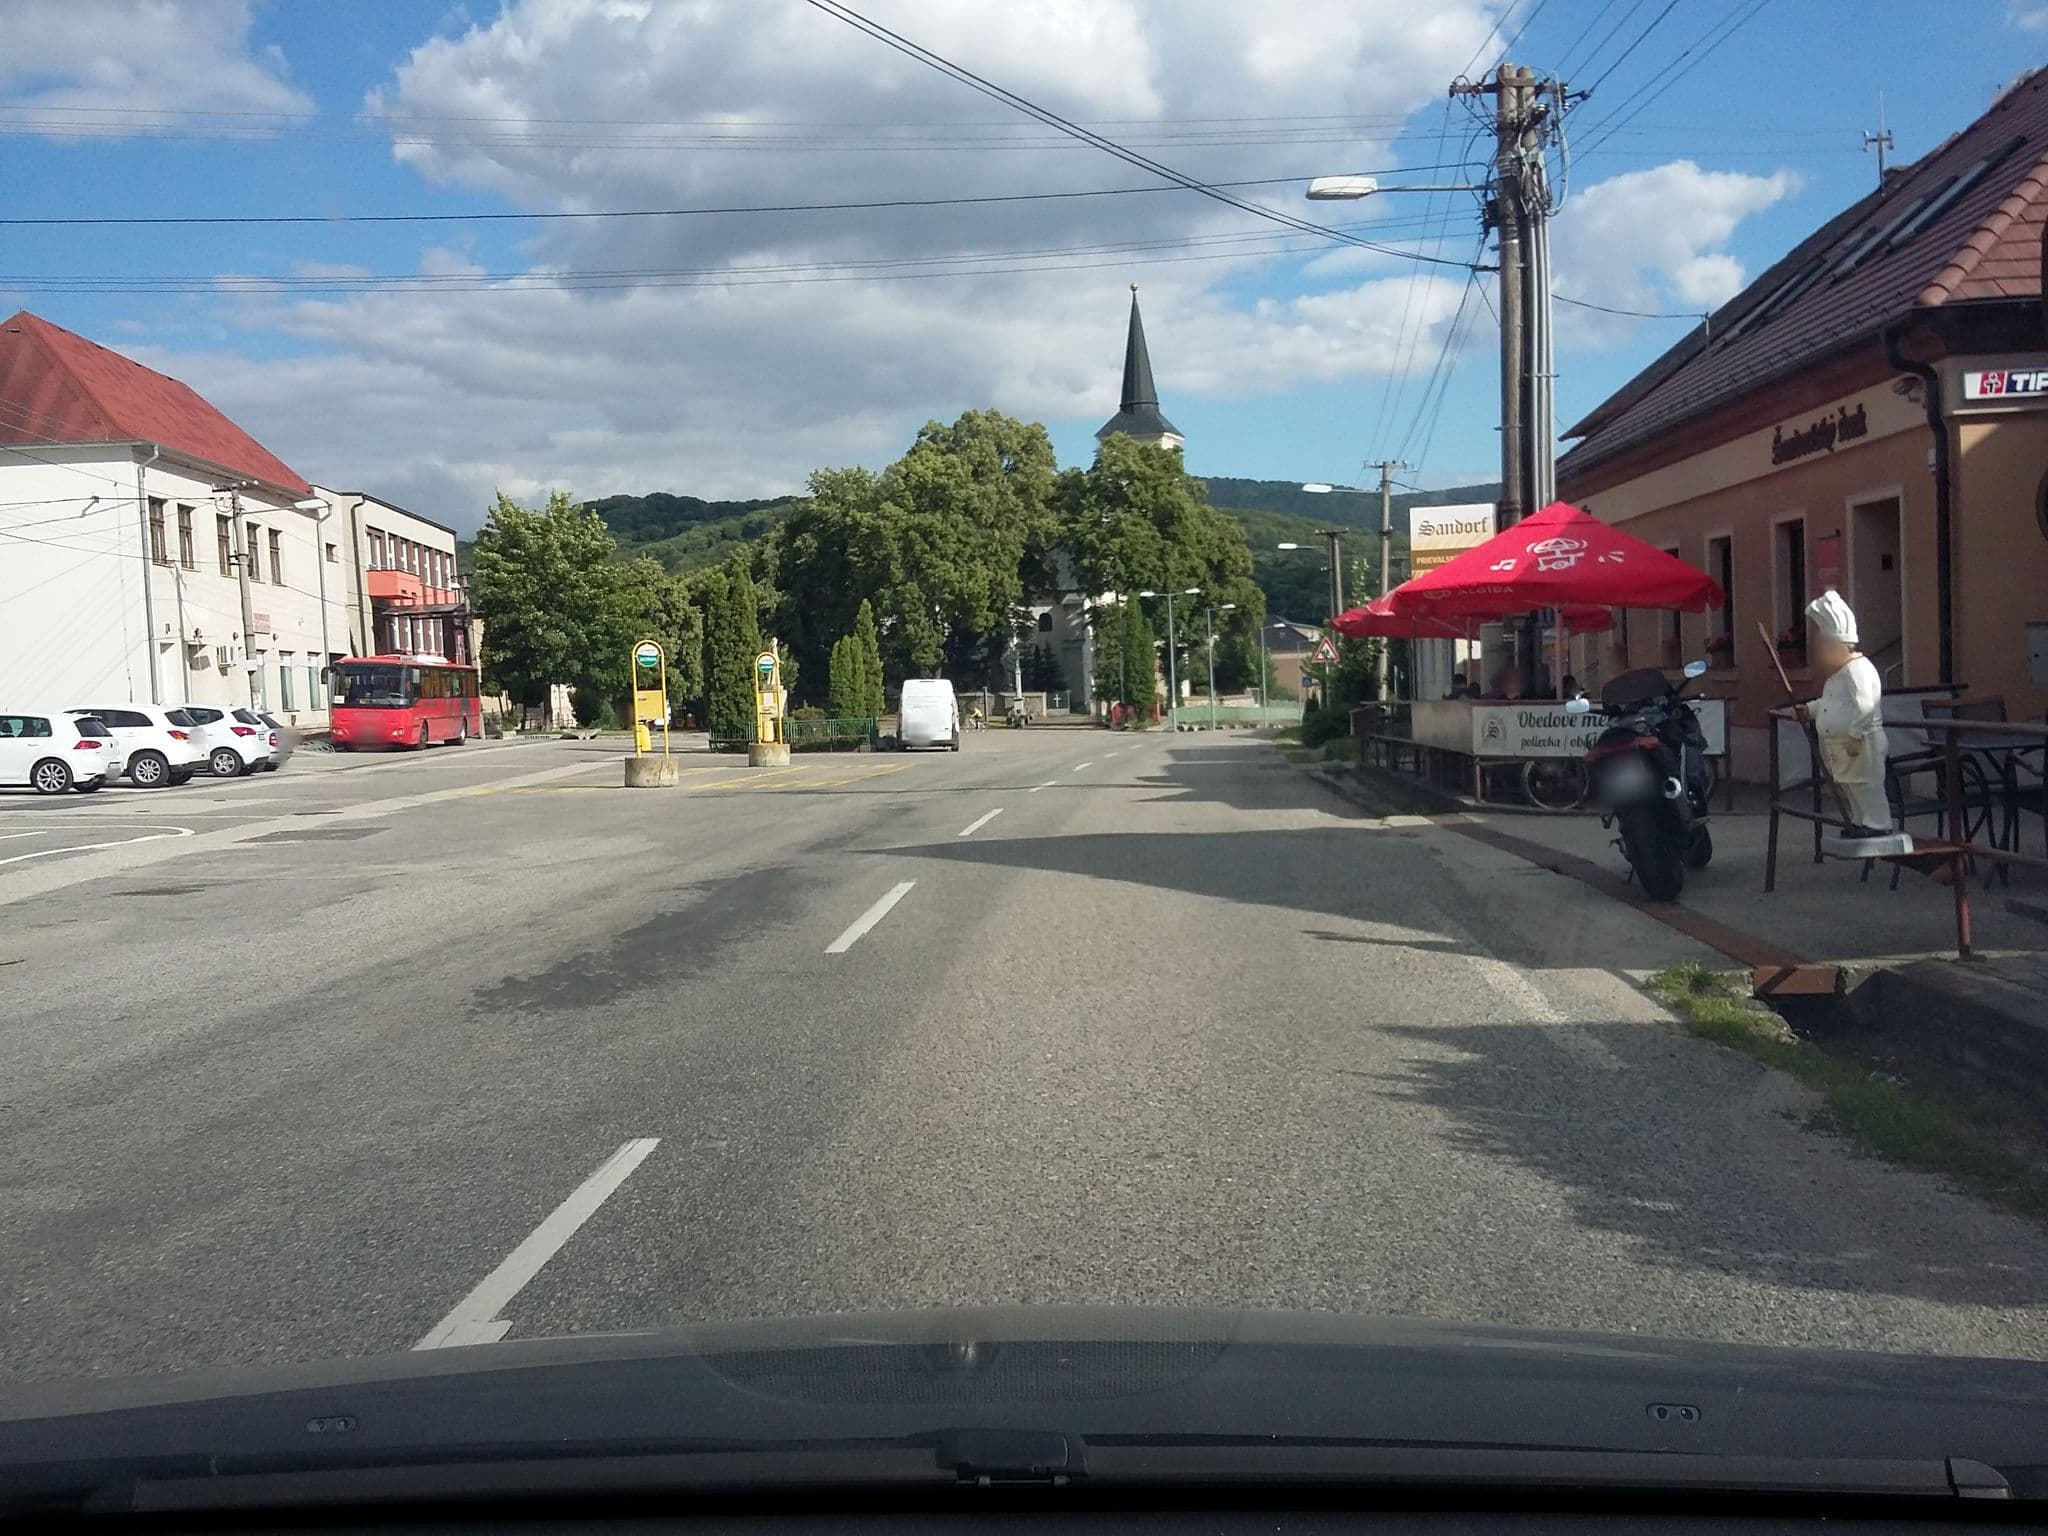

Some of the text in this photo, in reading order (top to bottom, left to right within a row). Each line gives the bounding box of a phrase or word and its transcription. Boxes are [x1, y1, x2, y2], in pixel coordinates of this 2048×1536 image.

[1418, 517, 1487, 536] Sandorf
[1416, 555, 1458, 565] PRIEVALSK
[1582, 713, 1607, 727] me
[1521, 735, 1561, 751] polievka
